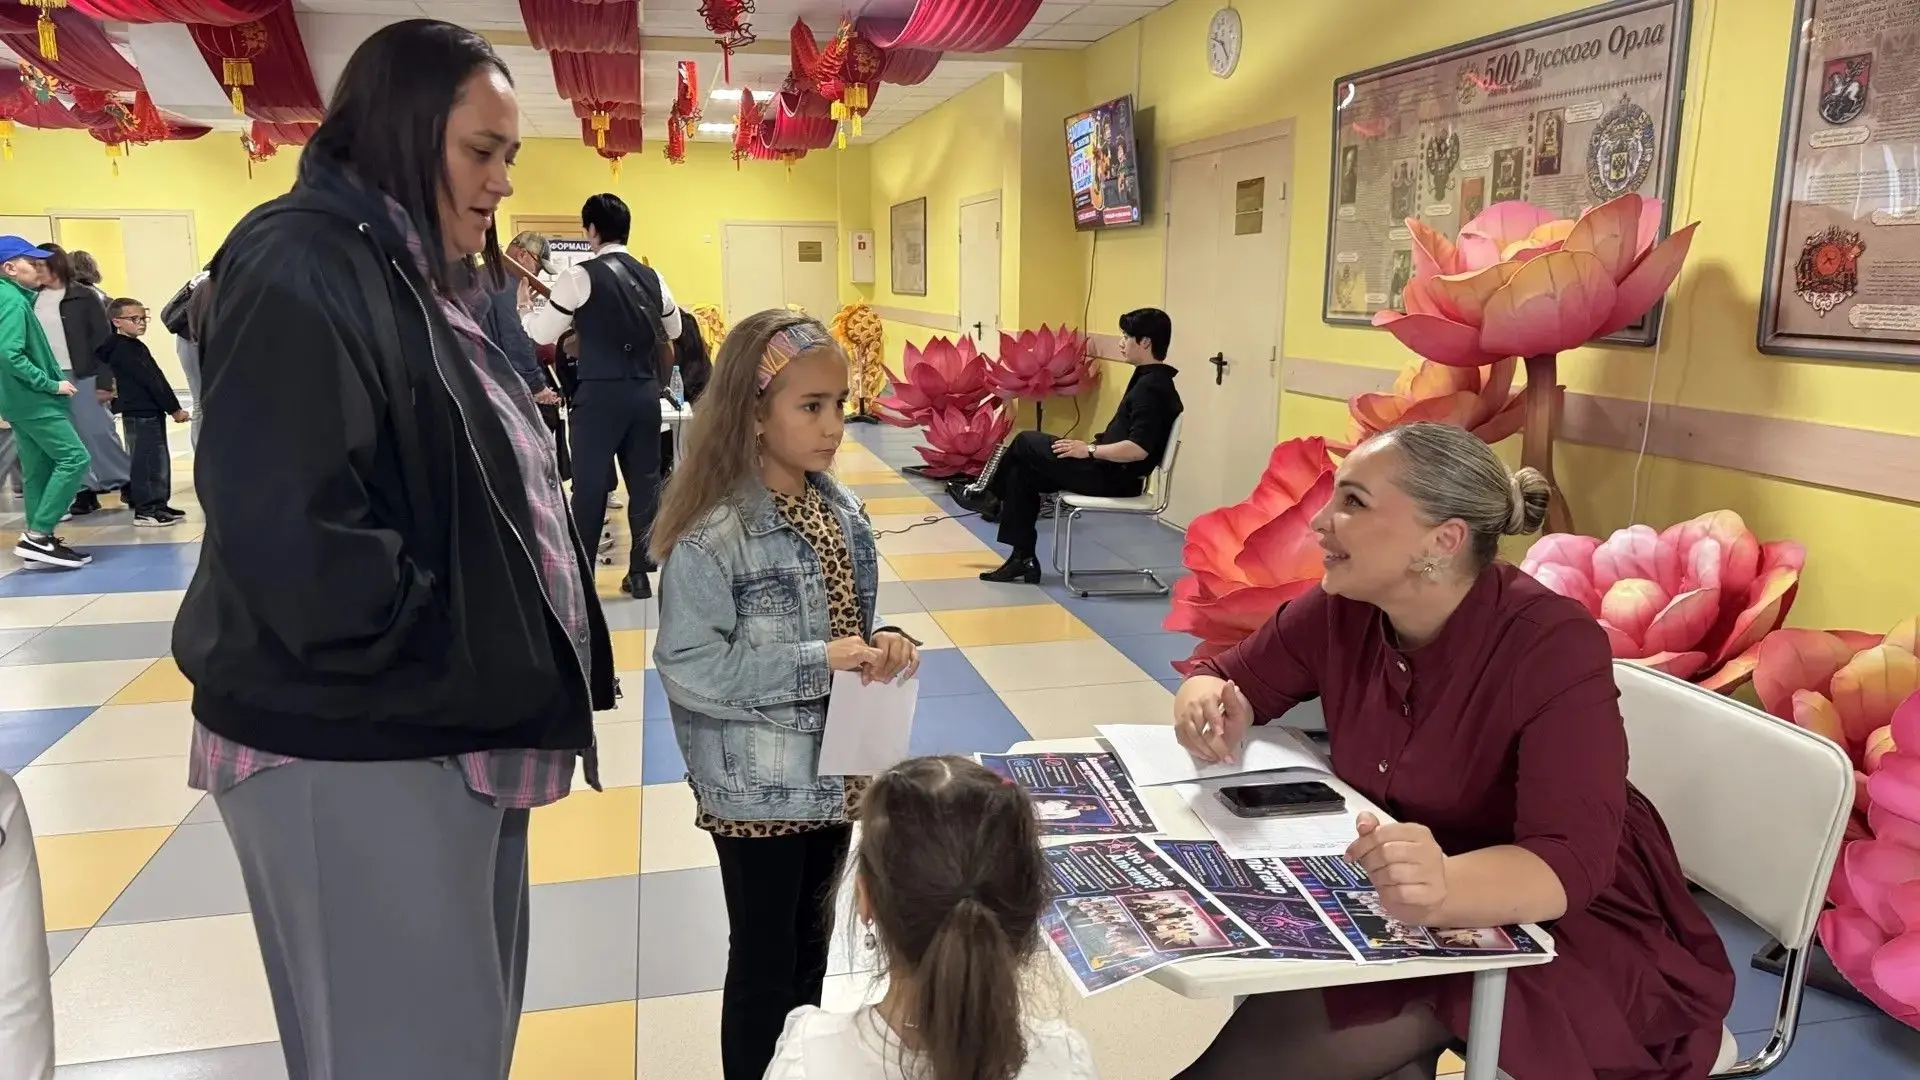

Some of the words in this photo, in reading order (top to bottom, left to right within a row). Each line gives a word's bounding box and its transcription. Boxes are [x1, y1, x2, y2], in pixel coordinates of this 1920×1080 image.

[1483, 50, 1521, 87] 500
[1520, 38, 1602, 77] Русского
[1608, 24, 1666, 59] Орла
[550, 242, 592, 251] ФОРМАЦИ
[1106, 854, 1161, 889] Альтаир?
[1125, 848, 1146, 865] Что
[1140, 863, 1174, 887] такое
[1245, 857, 1288, 894] льтаир
